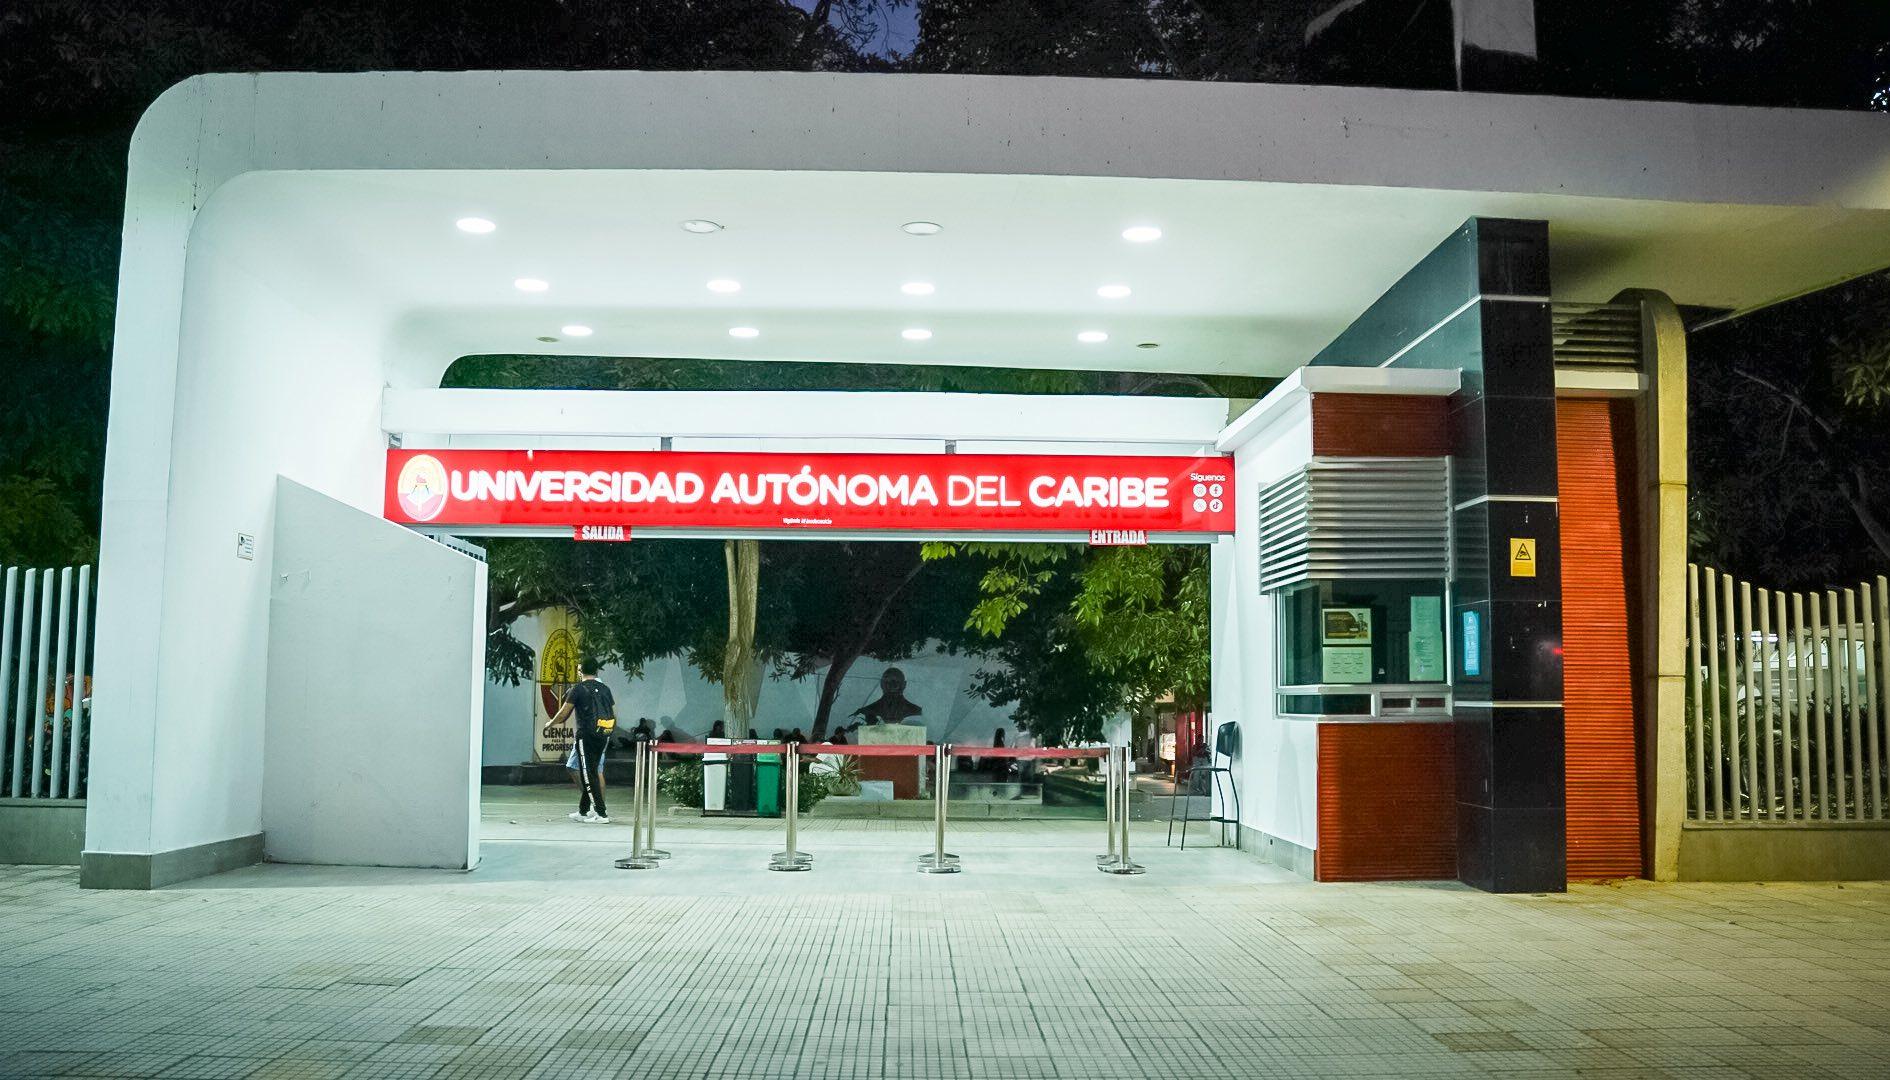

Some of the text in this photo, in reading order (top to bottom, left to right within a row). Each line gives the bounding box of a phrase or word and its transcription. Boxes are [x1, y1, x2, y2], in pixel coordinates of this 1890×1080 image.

[450, 464, 1169, 508] UNIVERSIDAD AUTÓNOMA DEL CARIBE
[582, 525, 624, 540] SALIDA
[1091, 529, 1146, 545] ENTRADA
[542, 727, 575, 739] CIENCIA
[542, 743, 574, 752] PROGRESO
